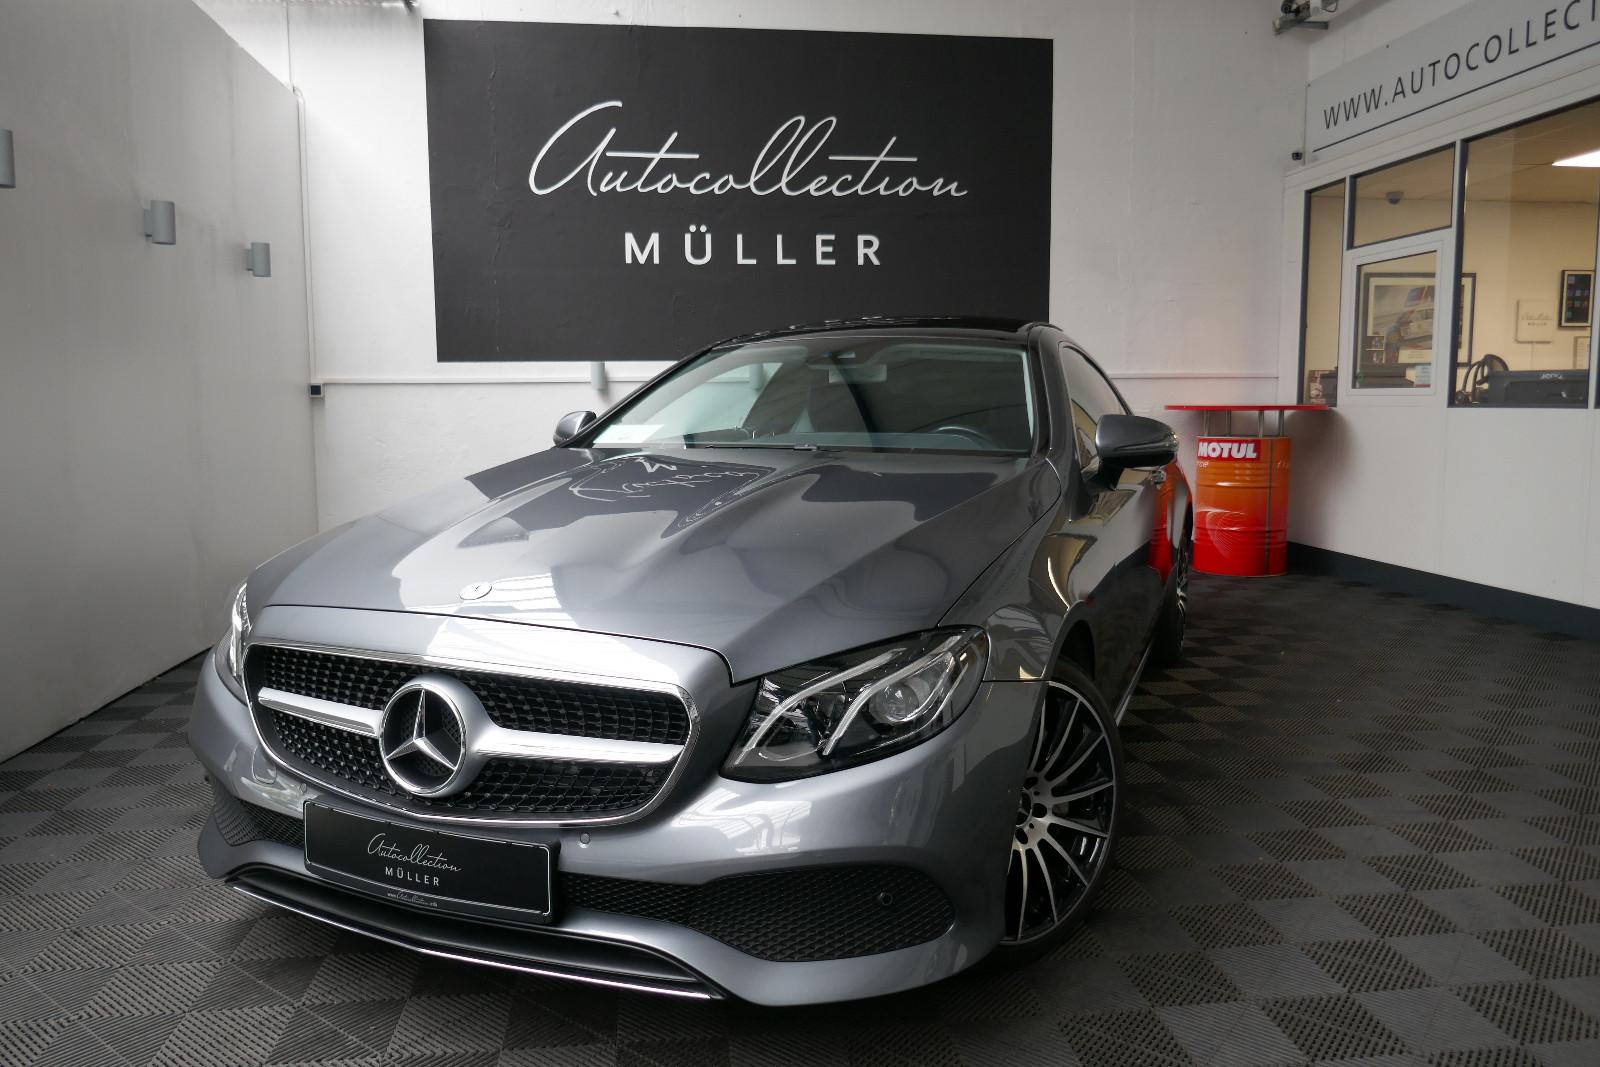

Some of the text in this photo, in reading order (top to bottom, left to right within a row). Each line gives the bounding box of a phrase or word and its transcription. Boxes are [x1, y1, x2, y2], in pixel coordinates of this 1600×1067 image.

[528, 100, 969, 197] Autocollection
[623, 224, 882, 266] MÜLLER
[1197, 442, 1257, 459] MOTUL
[367, 833, 461, 872] Autocollection
[385, 866, 440, 886] MÜLLER
